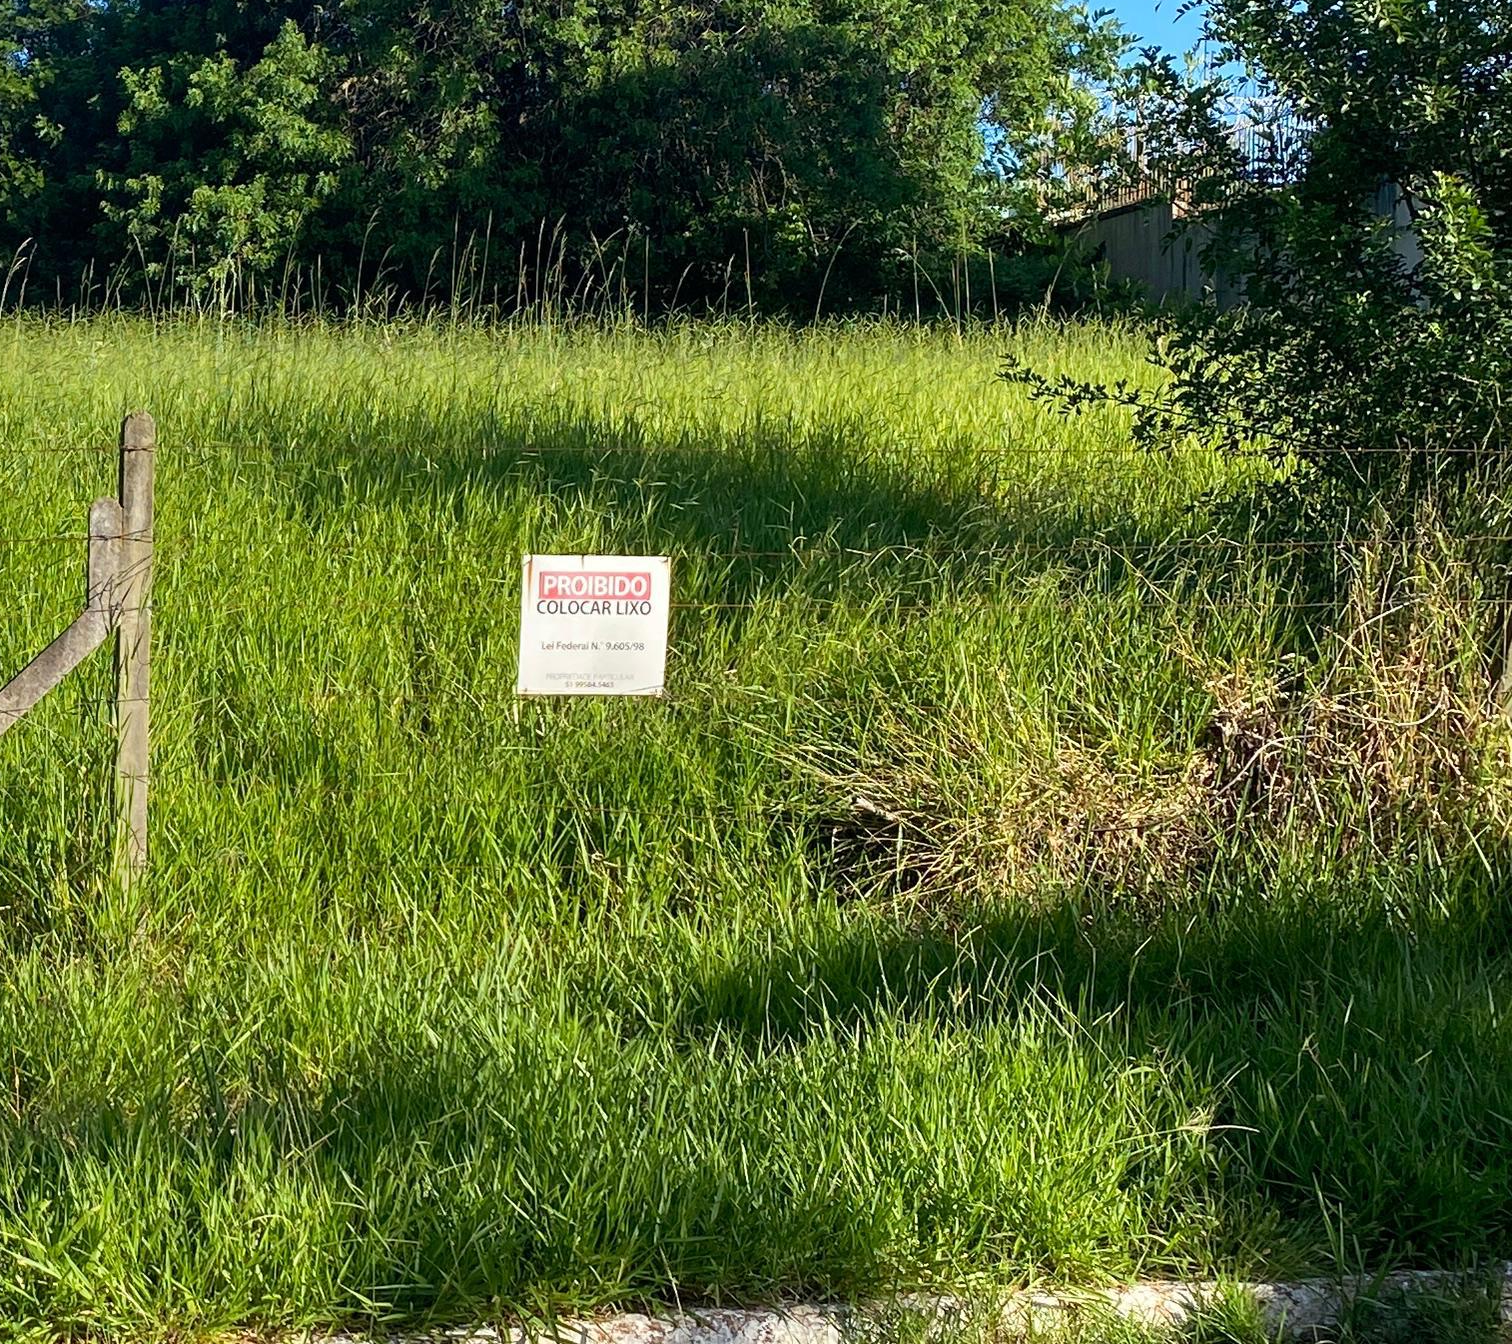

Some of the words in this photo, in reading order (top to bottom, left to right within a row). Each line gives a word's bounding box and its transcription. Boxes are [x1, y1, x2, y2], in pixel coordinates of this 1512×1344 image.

[543, 575, 648, 596] PROIBIDO
[537, 600, 611, 615] COLOCAR
[616, 601, 651, 616] LIXO
[541, 642, 554, 651] Lei
[556, 642, 589, 651] Federal
